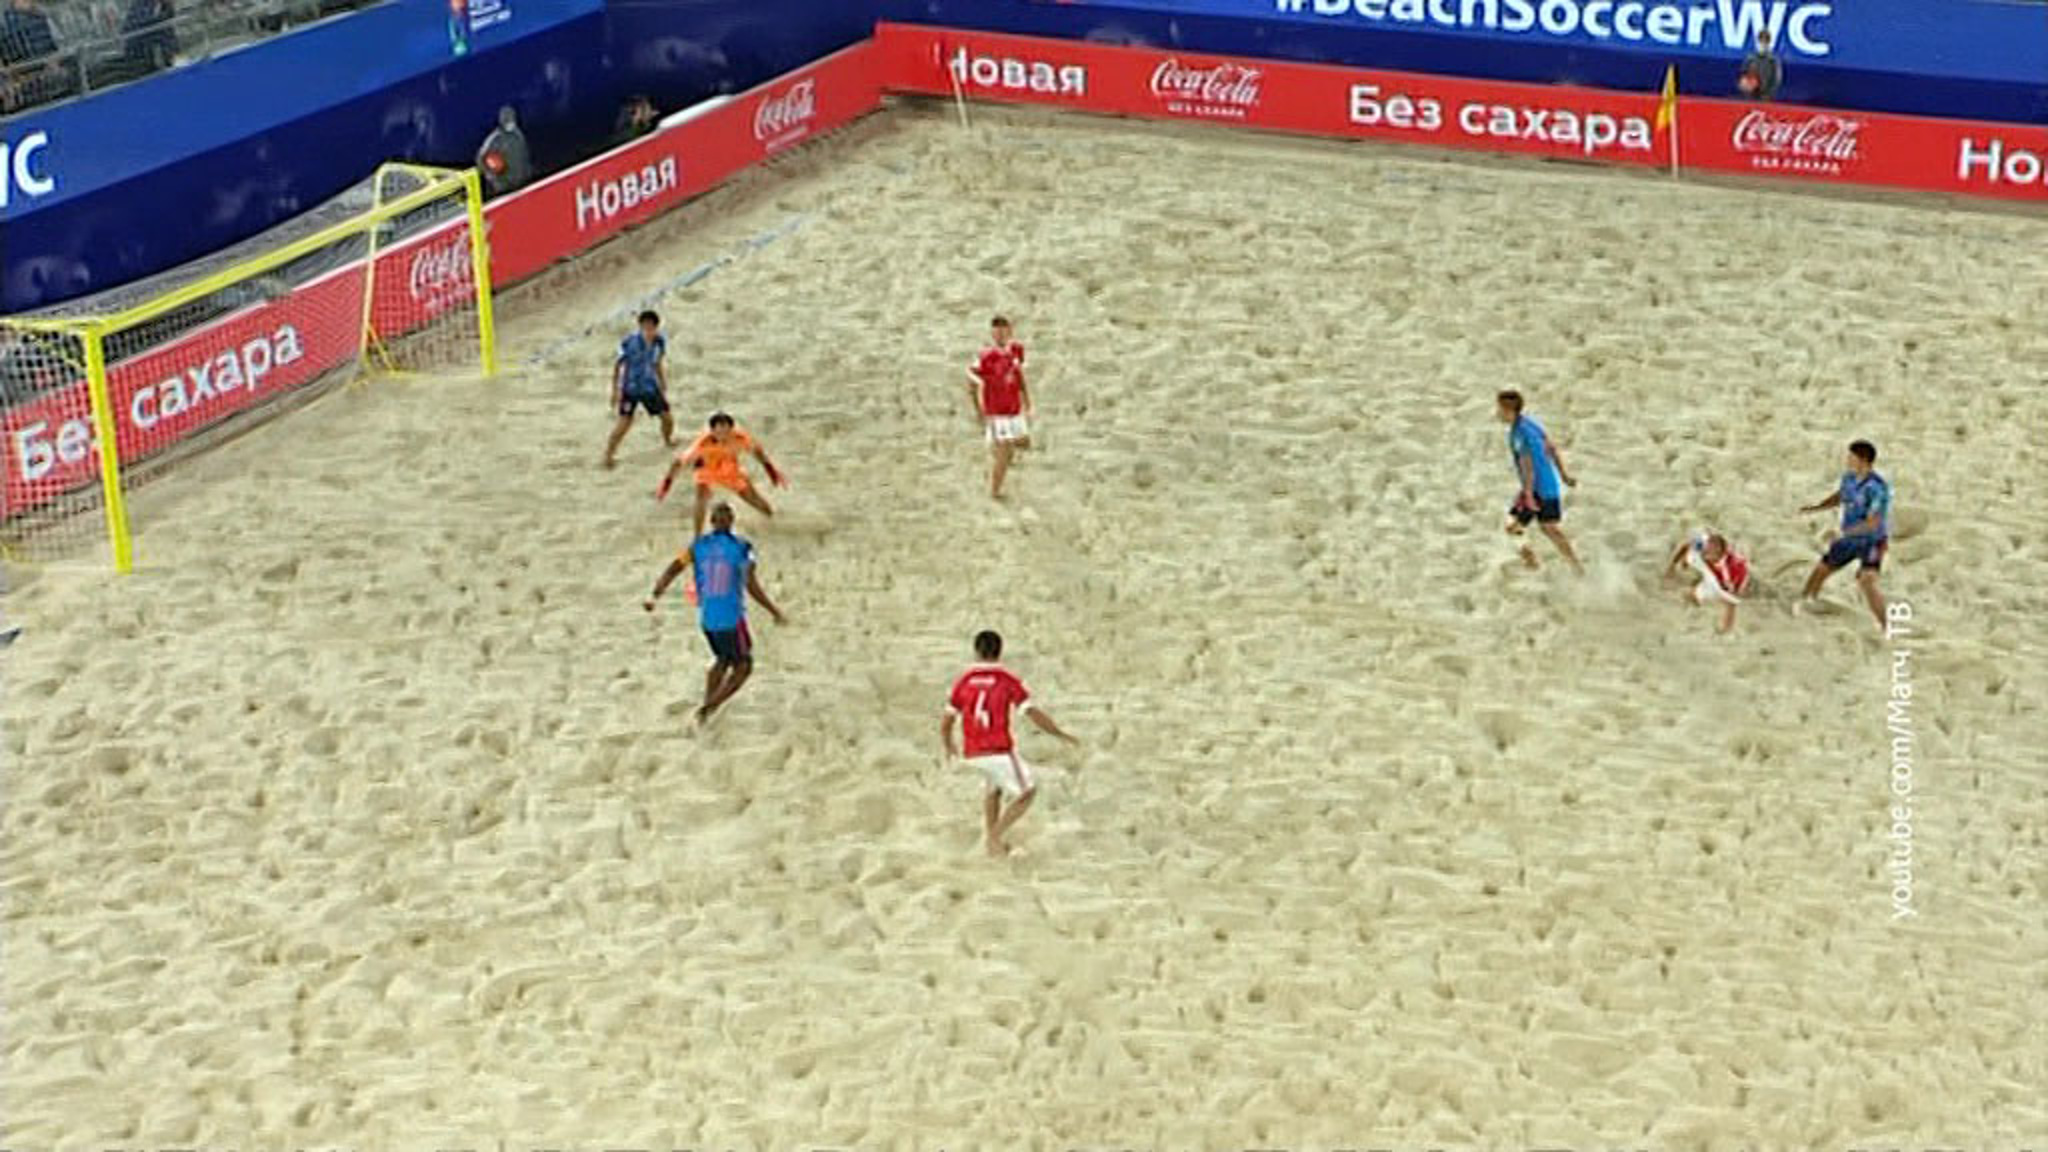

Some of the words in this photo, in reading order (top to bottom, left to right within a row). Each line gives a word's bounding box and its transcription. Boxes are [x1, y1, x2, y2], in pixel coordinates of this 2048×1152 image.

[1277, 0, 1831, 55] eachSoccerWC
[1350, 84, 1441, 130] Без
[1459, 103, 1652, 156] сахара
[0, 131, 55, 208] C
[575, 155, 678, 232] Новая
[1958, 137, 2048, 187] Но
[131, 323, 303, 431] сахара
[973, 689, 991, 730] 4
